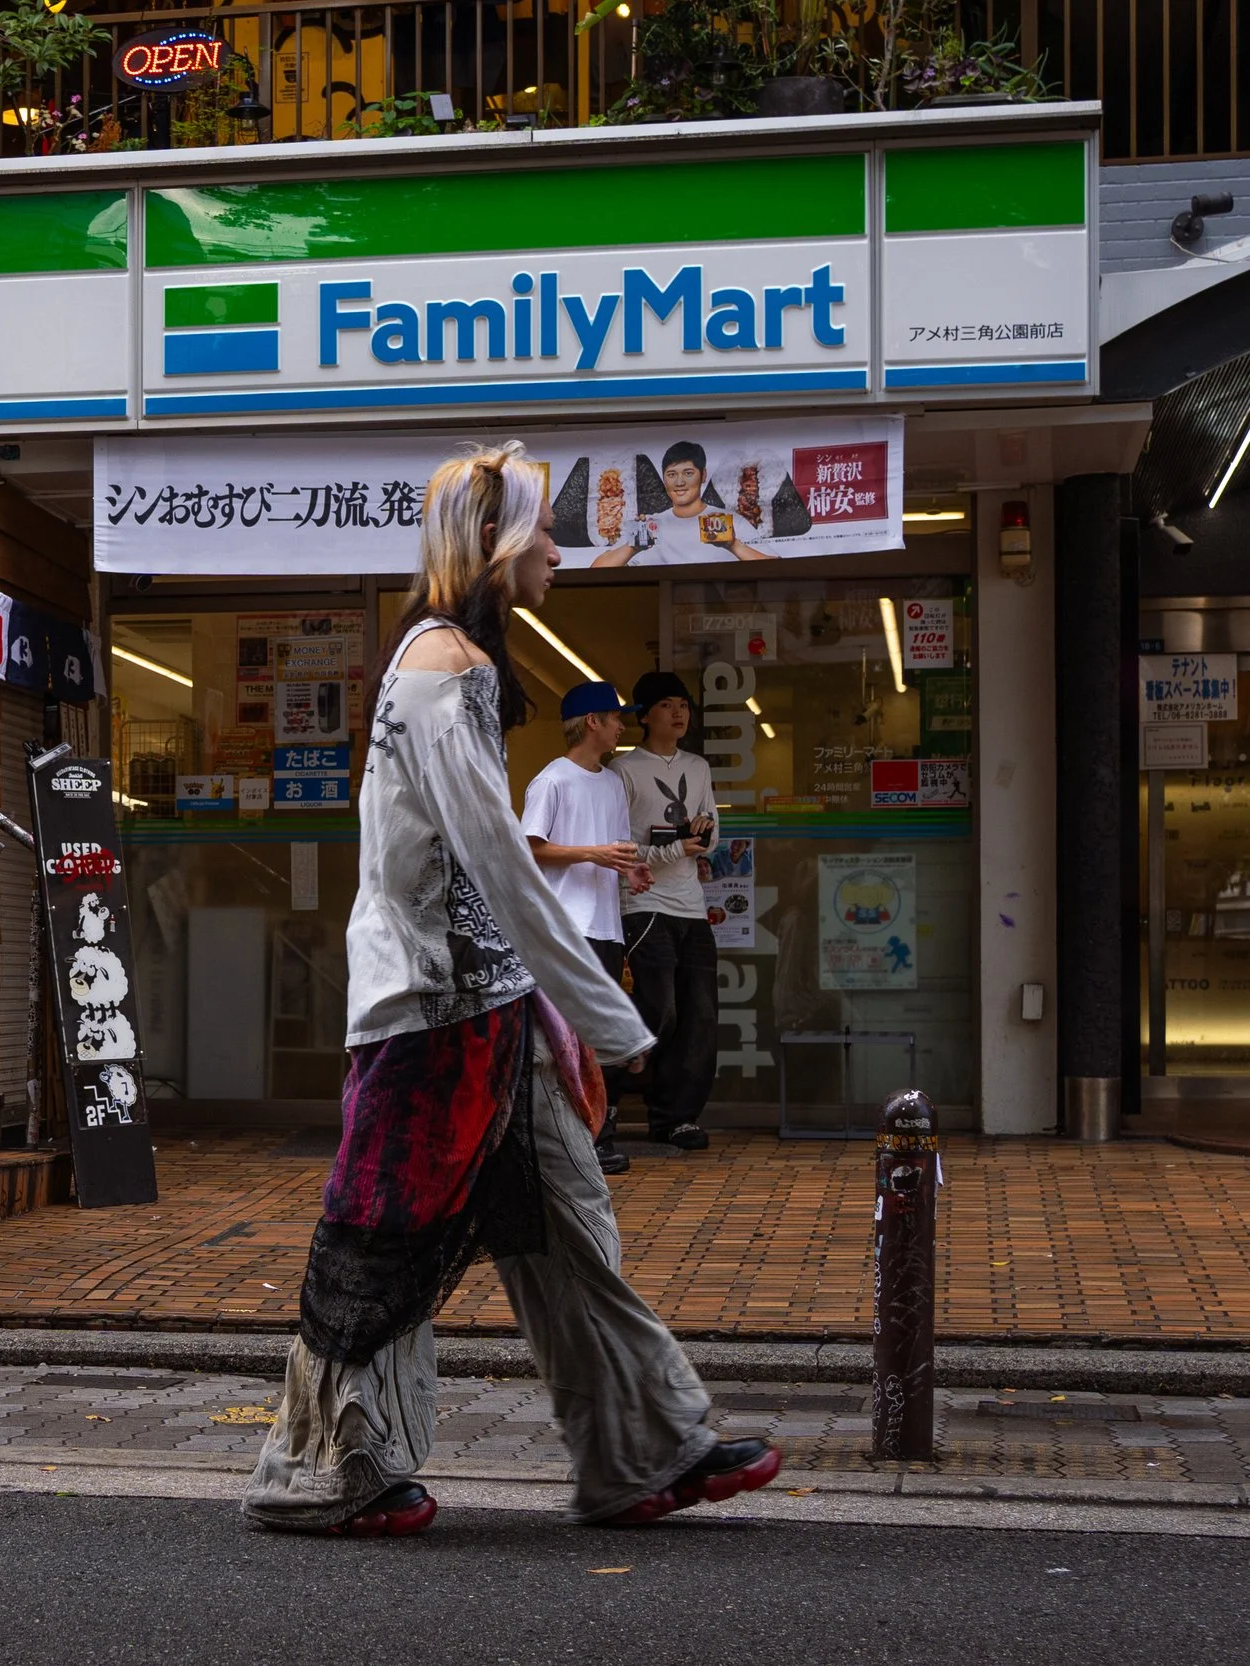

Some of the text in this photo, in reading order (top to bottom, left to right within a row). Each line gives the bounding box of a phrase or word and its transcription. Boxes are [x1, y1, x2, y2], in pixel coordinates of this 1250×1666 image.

[122, 41, 222, 75] OPEN
[319, 263, 845, 370] FamilyMart
[909, 323, 1063, 343] アメ村三角公園前店
[285, 658, 336, 667] EXCHANGE
[1172, 656, 1207, 677] テナント
[286, 750, 337, 768] たばこ
[51, 778, 102, 791] SHEEP
[286, 781, 338, 799] お酒
[875, 793, 916, 803] SECOM
[61, 842, 102, 858] USED
